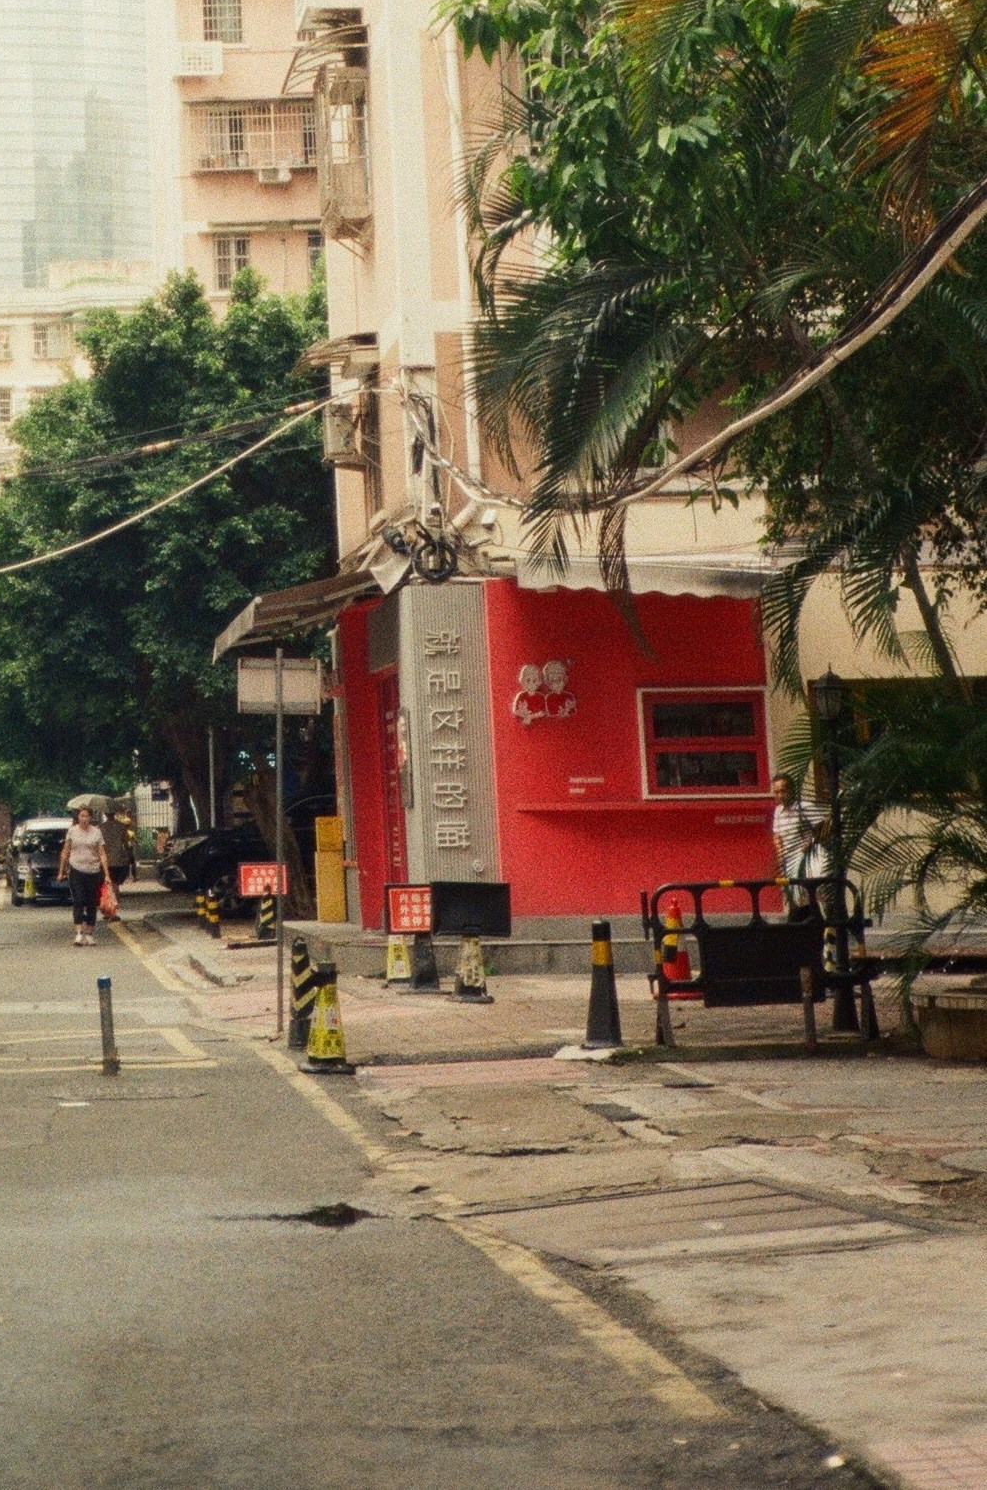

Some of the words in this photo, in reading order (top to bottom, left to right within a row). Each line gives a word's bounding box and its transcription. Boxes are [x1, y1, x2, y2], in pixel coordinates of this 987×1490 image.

[424, 629, 470, 849] 就是这样的喵
